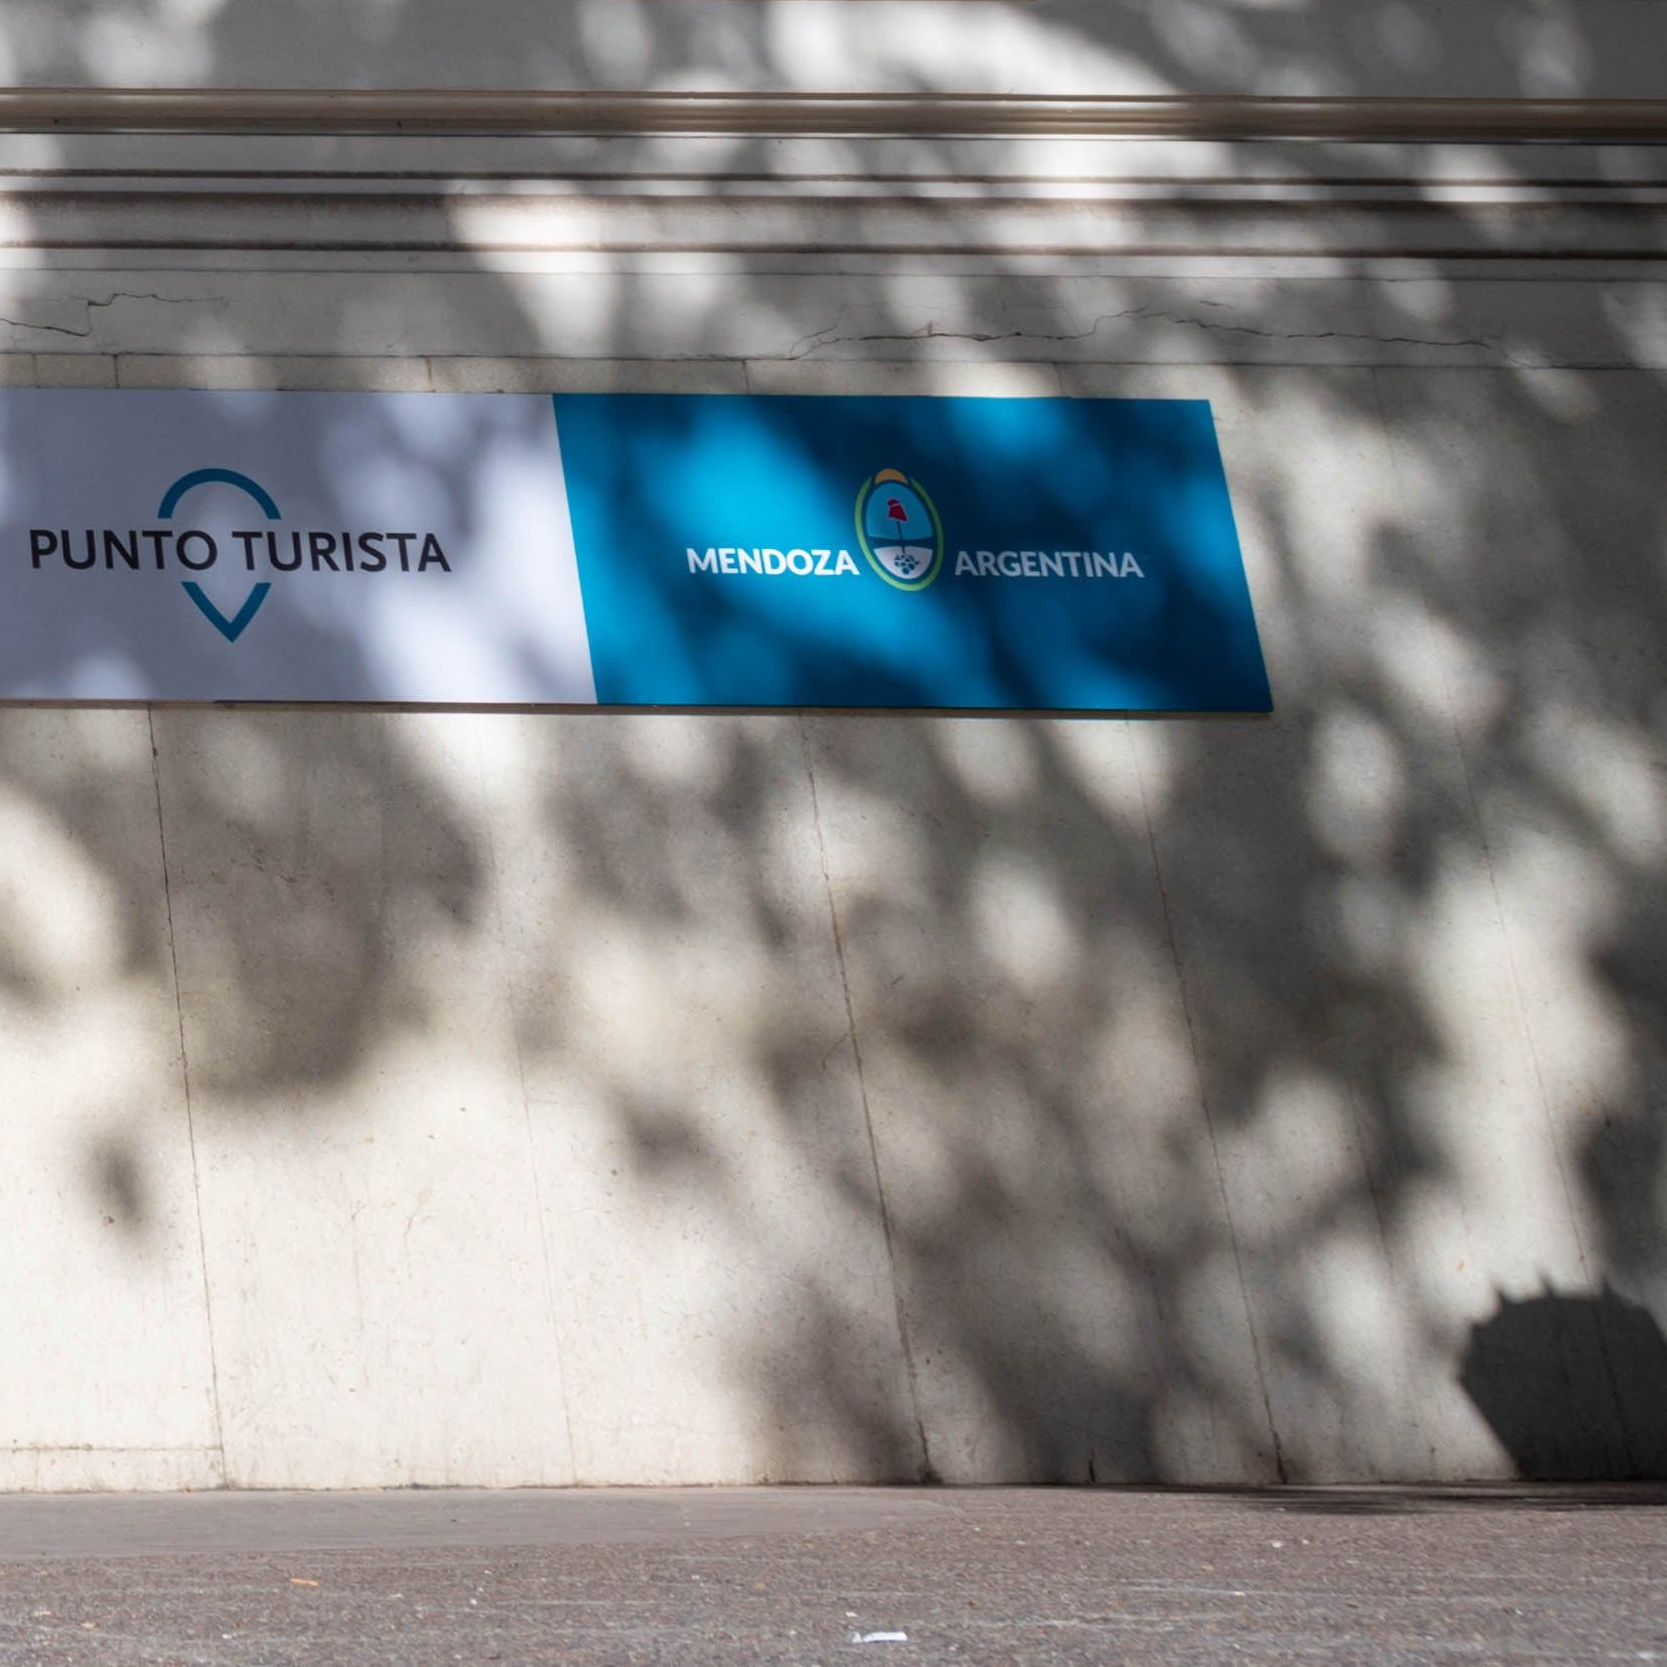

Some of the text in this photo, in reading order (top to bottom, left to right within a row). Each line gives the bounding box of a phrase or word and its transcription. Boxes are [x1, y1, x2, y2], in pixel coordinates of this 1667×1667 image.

[29, 529, 452, 573] PUNTO TURISTA
[686, 547, 1145, 578] MENDOZA ARGENTINA
